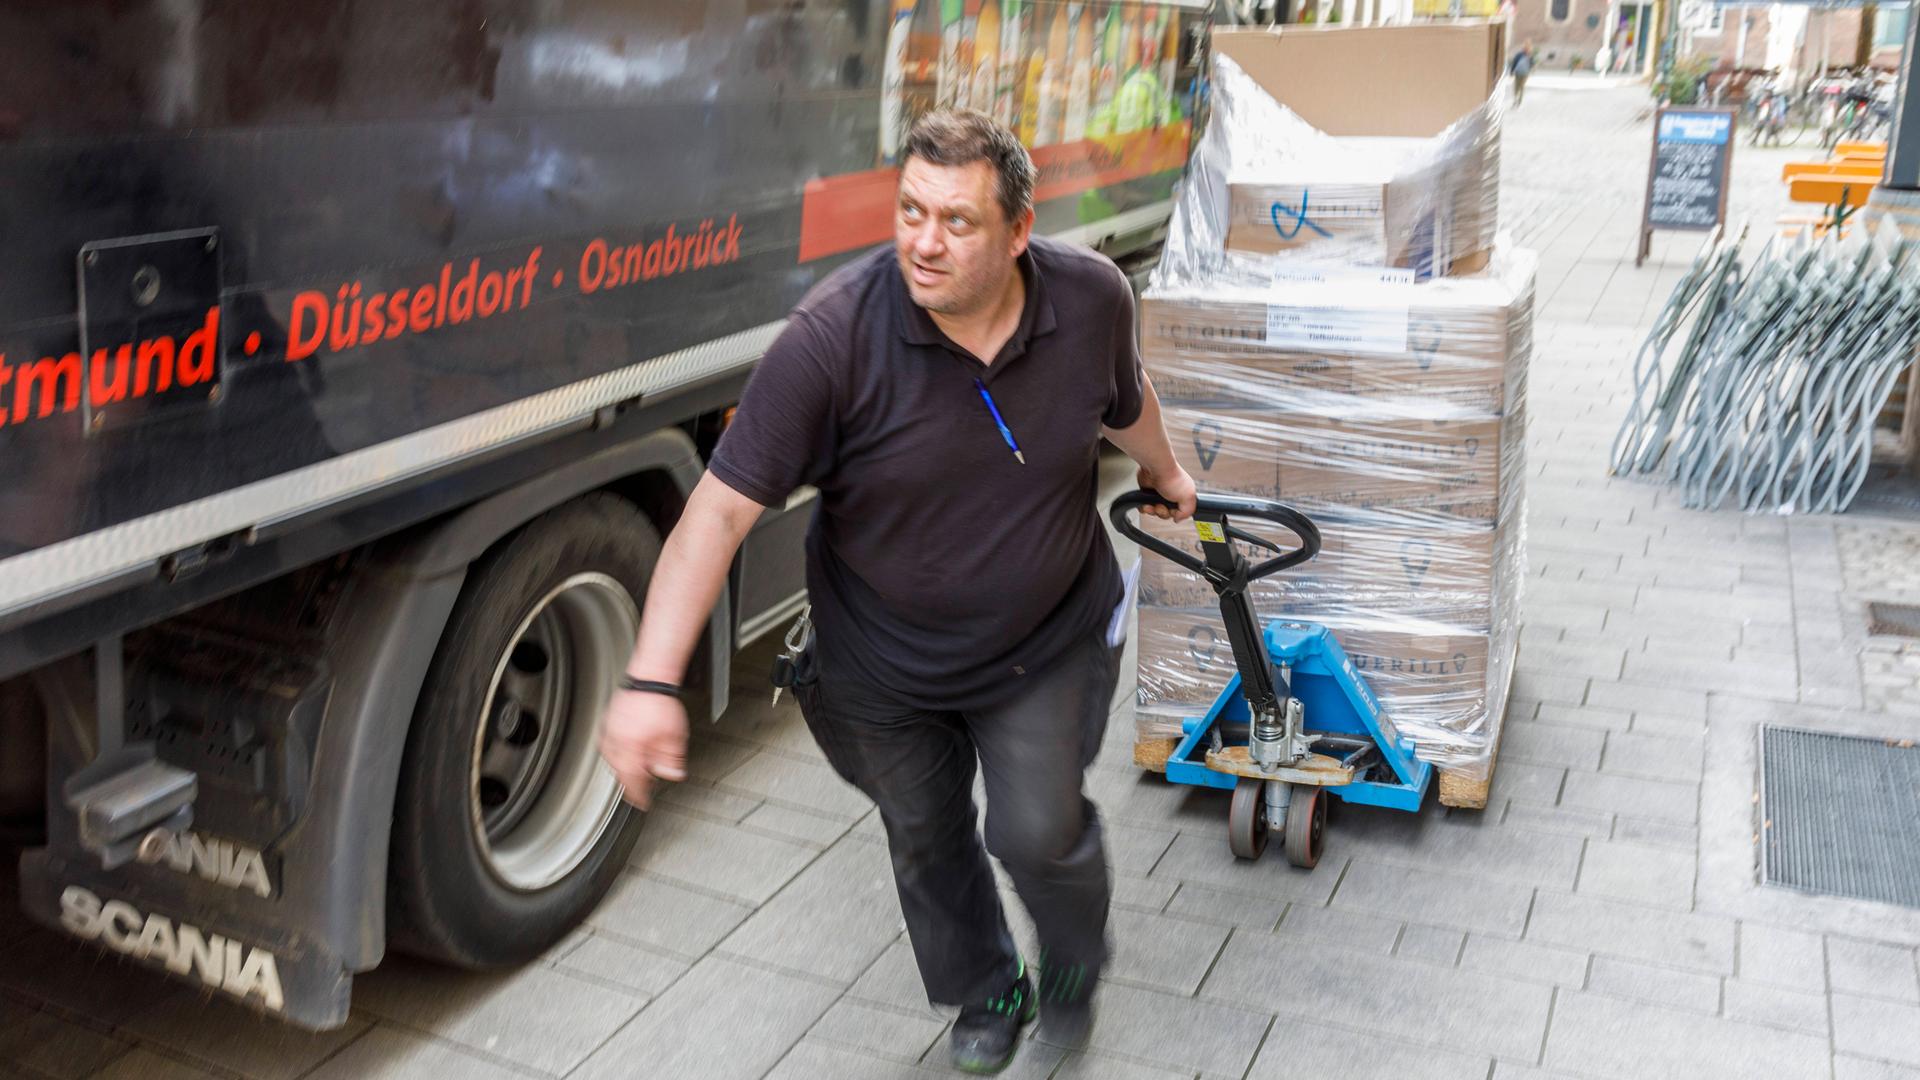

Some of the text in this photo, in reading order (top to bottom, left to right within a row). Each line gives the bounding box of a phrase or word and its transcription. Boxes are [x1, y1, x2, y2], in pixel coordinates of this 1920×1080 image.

[284, 245, 543, 363] Düsseldorf
[578, 212, 744, 295] Osnabrück
[60, 885, 285, 1012] SCANIA
